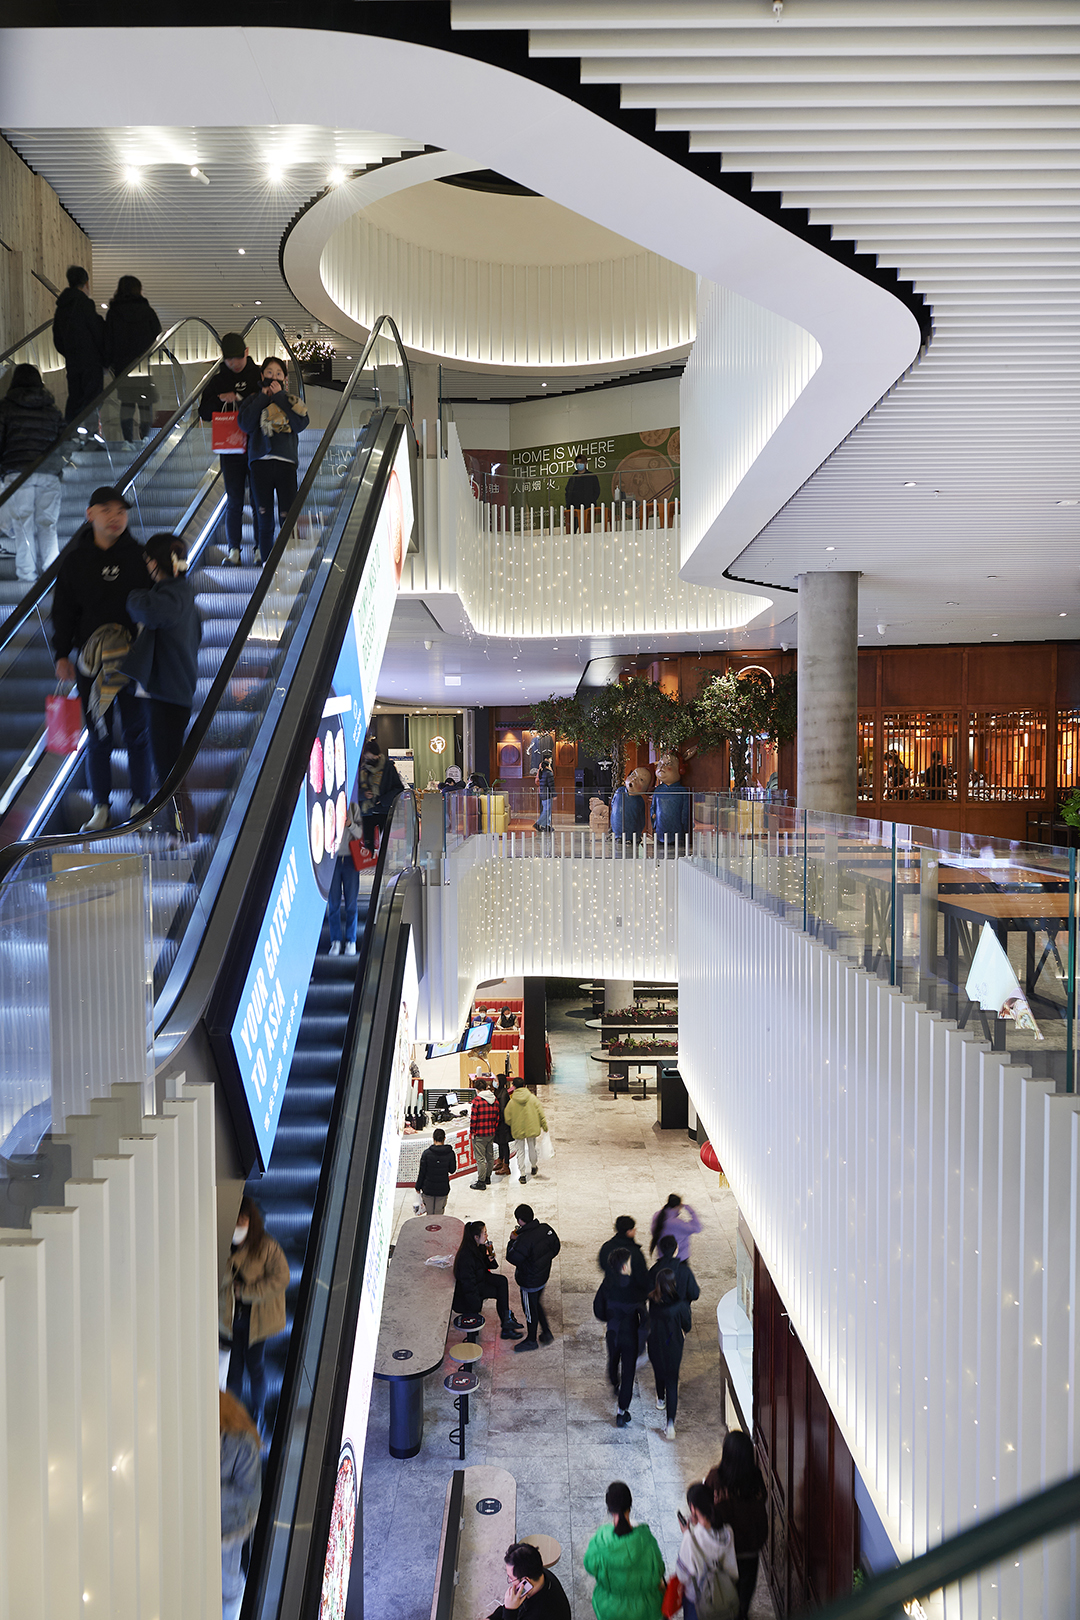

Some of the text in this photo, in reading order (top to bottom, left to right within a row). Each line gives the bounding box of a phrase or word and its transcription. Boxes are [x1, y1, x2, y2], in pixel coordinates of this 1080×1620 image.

[513, 440, 615, 465] HOME IS WHERE
[513, 465, 536, 478] THE
[595, 456, 607, 469] IS
[240, 846, 298, 1061] YOUR GATEWAY
[251, 977, 286, 1103] TO ASIA
